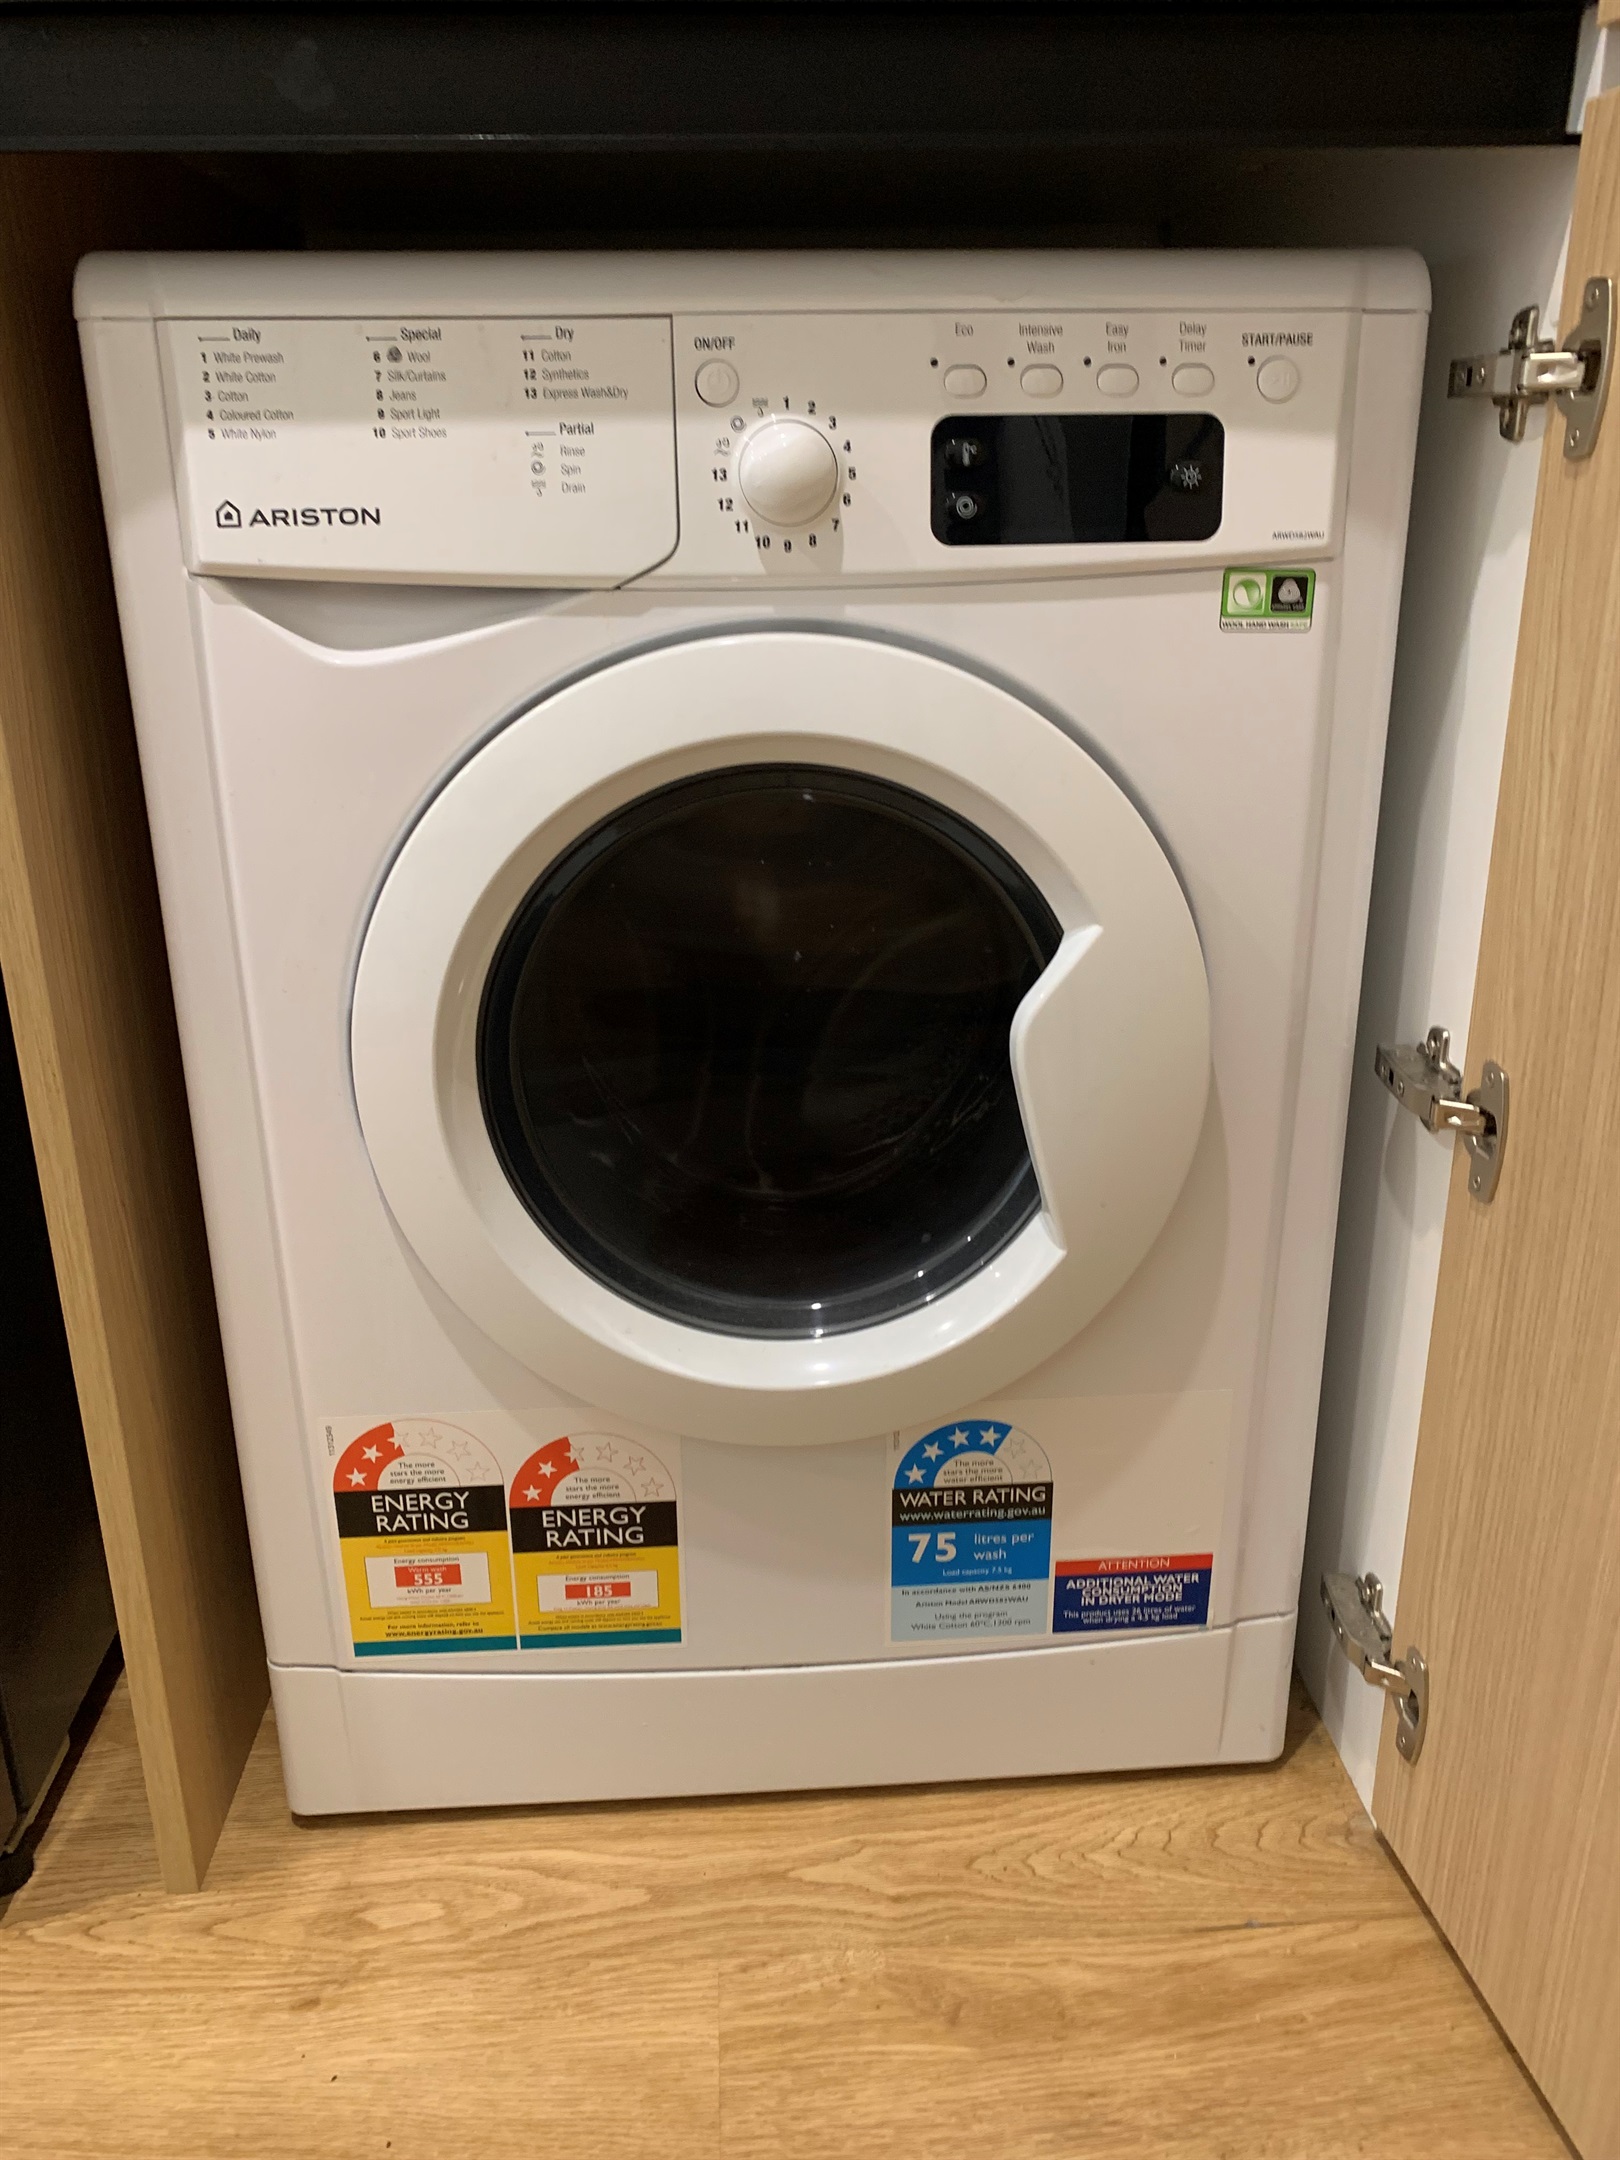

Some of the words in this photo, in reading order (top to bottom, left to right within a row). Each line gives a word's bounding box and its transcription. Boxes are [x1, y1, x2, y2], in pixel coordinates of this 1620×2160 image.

[232, 327, 261, 344] Daily
[400, 327, 442, 343] Special
[555, 326, 574, 343] Dry
[955, 322, 974, 337] Eco
[1019, 322, 1063, 336] Intensive
[1106, 321, 1128, 338] Easy
[1179, 321, 1207, 337] Delay
[694, 337, 735, 350] ON/OFF
[1180, 340, 1206, 352] Timer
[1242, 332, 1313, 347] START/PAUSE
[1027, 341, 1055, 353] Wash
[1107, 341, 1126, 352] Iron
[201, 352, 207, 363] 1
[213, 351, 241, 364] White
[243, 351, 284, 363] Prewash
[373, 351, 381, 362] 6
[407, 351, 431, 363] Wool
[522, 350, 535, 361] 11
[541, 350, 572, 362] Cotton
[202, 371, 210, 383] 2
[216, 371, 243, 383] White
[246, 370, 276, 383] Cotton
[374, 371, 381, 382] 7
[387, 370, 446, 382] Silk/Curtains
[524, 369, 536, 381] 12
[541, 368, 589, 382] Synthetics
[205, 390, 212, 401] 3
[217, 389, 249, 402] Cotton
[376, 389, 383, 401] 8
[389, 389, 417, 402] Jeans
[525, 388, 537, 399] 13
[542, 388, 578, 401] Express
[581, 387, 628, 400] Wash&Dry
[783, 396, 790, 410] 1
[808, 401, 816, 415] 2
[206, 409, 214, 420] 4
[220, 409, 261, 421] Coloured
[263, 408, 294, 420] Cotton
[377, 408, 385, 420] 9
[390, 408, 415, 422] Sport
[417, 408, 440, 422] Light
[559, 422, 595, 436] Partial
[829, 416, 837, 429] 3
[208, 428, 215, 439] 5
[221, 428, 248, 439] White
[250, 428, 276, 441] Nylon
[373, 427, 386, 438] 10
[391, 427, 417, 440] Sport
[418, 426, 447, 439] Shoes
[559, 446, 585, 458] Rinse
[844, 440, 851, 453] 4
[561, 464, 581, 477] Spin
[712, 468, 727, 481] 13
[848, 467, 856, 480] 5
[561, 482, 586, 494] Drain
[718, 498, 733, 511] 12
[843, 493, 851, 506] 6
[250, 508, 382, 527] ARISTON
[735, 520, 748, 533] 11
[832, 518, 840, 531] 7
[755, 535, 770, 549] 10
[784, 540, 792, 553] 9
[809, 534, 817, 547] 8
[954, 1459, 970, 1467] The
[972, 1459, 994, 1467] more
[943, 1468, 963, 1476] stars
[965, 1467, 978, 1475] the
[390, 1477, 415, 1485] energy
[417, 1476, 446, 1484] efficient
[943, 1476, 967, 1484] water
[970, 1475, 1003, 1483] efficient
[592, 1491, 620, 1499] efficient
[900, 1489, 966, 1508] WATER
[973, 1486, 1046, 1505] RATING
[371, 1491, 470, 1513] ENERGY
[542, 1506, 647, 1528] ENERGY
[899, 1506, 1046, 1521] www.waterrating.gov.au
[376, 1512, 469, 1533] RATING
[546, 1527, 644, 1548] RATING
[974, 1533, 1007, 1545] litres
[1012, 1533, 1034, 1545] per
[908, 1532, 957, 1563] 75
[974, 1548, 1007, 1560] wash
[1098, 1558, 1170, 1571] ATTENTION
[943, 1568, 960, 1576] Load
[414, 1573, 443, 1585] 555
[1066, 1575, 1148, 1590] ADDITIONAL
[1153, 1572, 1199, 1584] WATER
[586, 1585, 613, 1598] 185
[1082, 1583, 1183, 1598] CONSUMPTION
[1081, 1597, 1095, 1606] IN
[1099, 1595, 1140, 1606] DRYER
[1144, 1592, 1183, 1603] MODE
[911, 1623, 936, 1631] White
